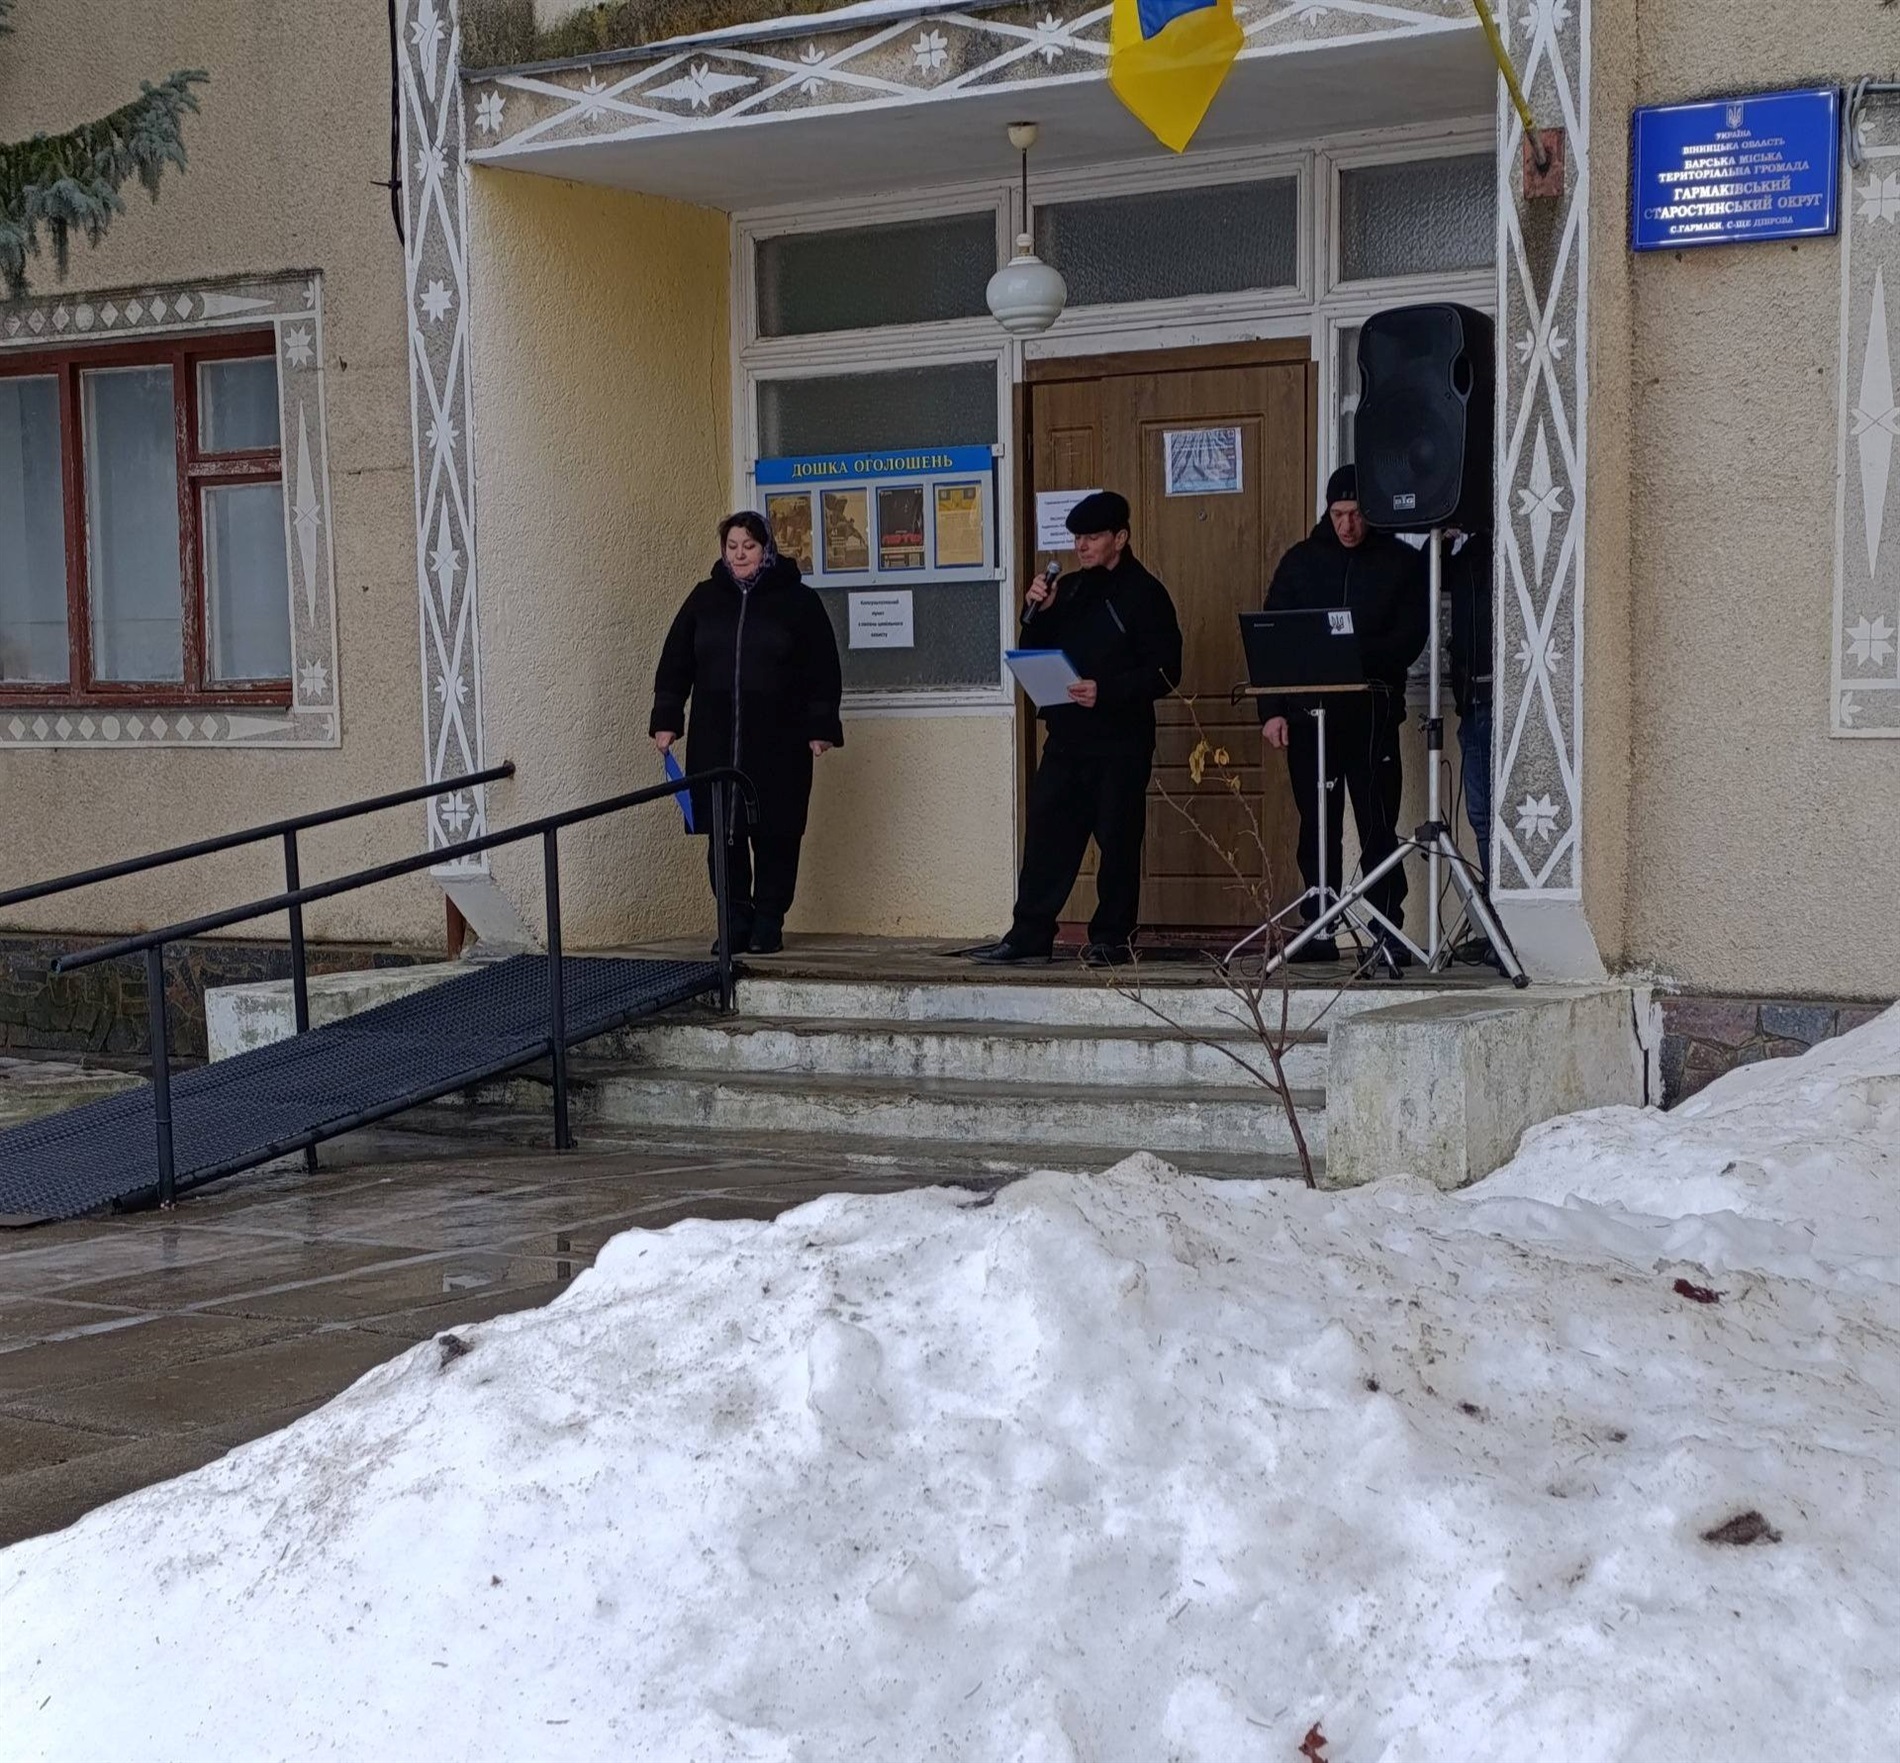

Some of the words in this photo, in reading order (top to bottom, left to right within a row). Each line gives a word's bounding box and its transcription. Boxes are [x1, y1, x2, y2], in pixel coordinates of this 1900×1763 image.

[1715, 130, 1752, 140] УКРАЇНА
[1682, 142, 1739, 155] ВІННИЦЬКА
[1741, 138, 1785, 149] ОБЛАСТЬ
[1684, 156, 1736, 170] БАРСЬКА
[1739, 151, 1783, 164] МІСЬКА
[1658, 166, 1751, 184] ТЕРИТОРІАЛЬНА
[1754, 161, 1810, 175] ГРОМАДА
[1673, 176, 1791, 201] ГАРМАКІВСЬКИЙ
[1644, 195, 1773, 220] СТАРОСТИНСЬКИЙ
[1777, 194, 1823, 208] ОКРУГ
[1753, 216, 1794, 227] ДІБРОВА
[791, 461, 848, 479] ДОШКА
[854, 454, 953, 474] ОГОЛОШЕНЬ
